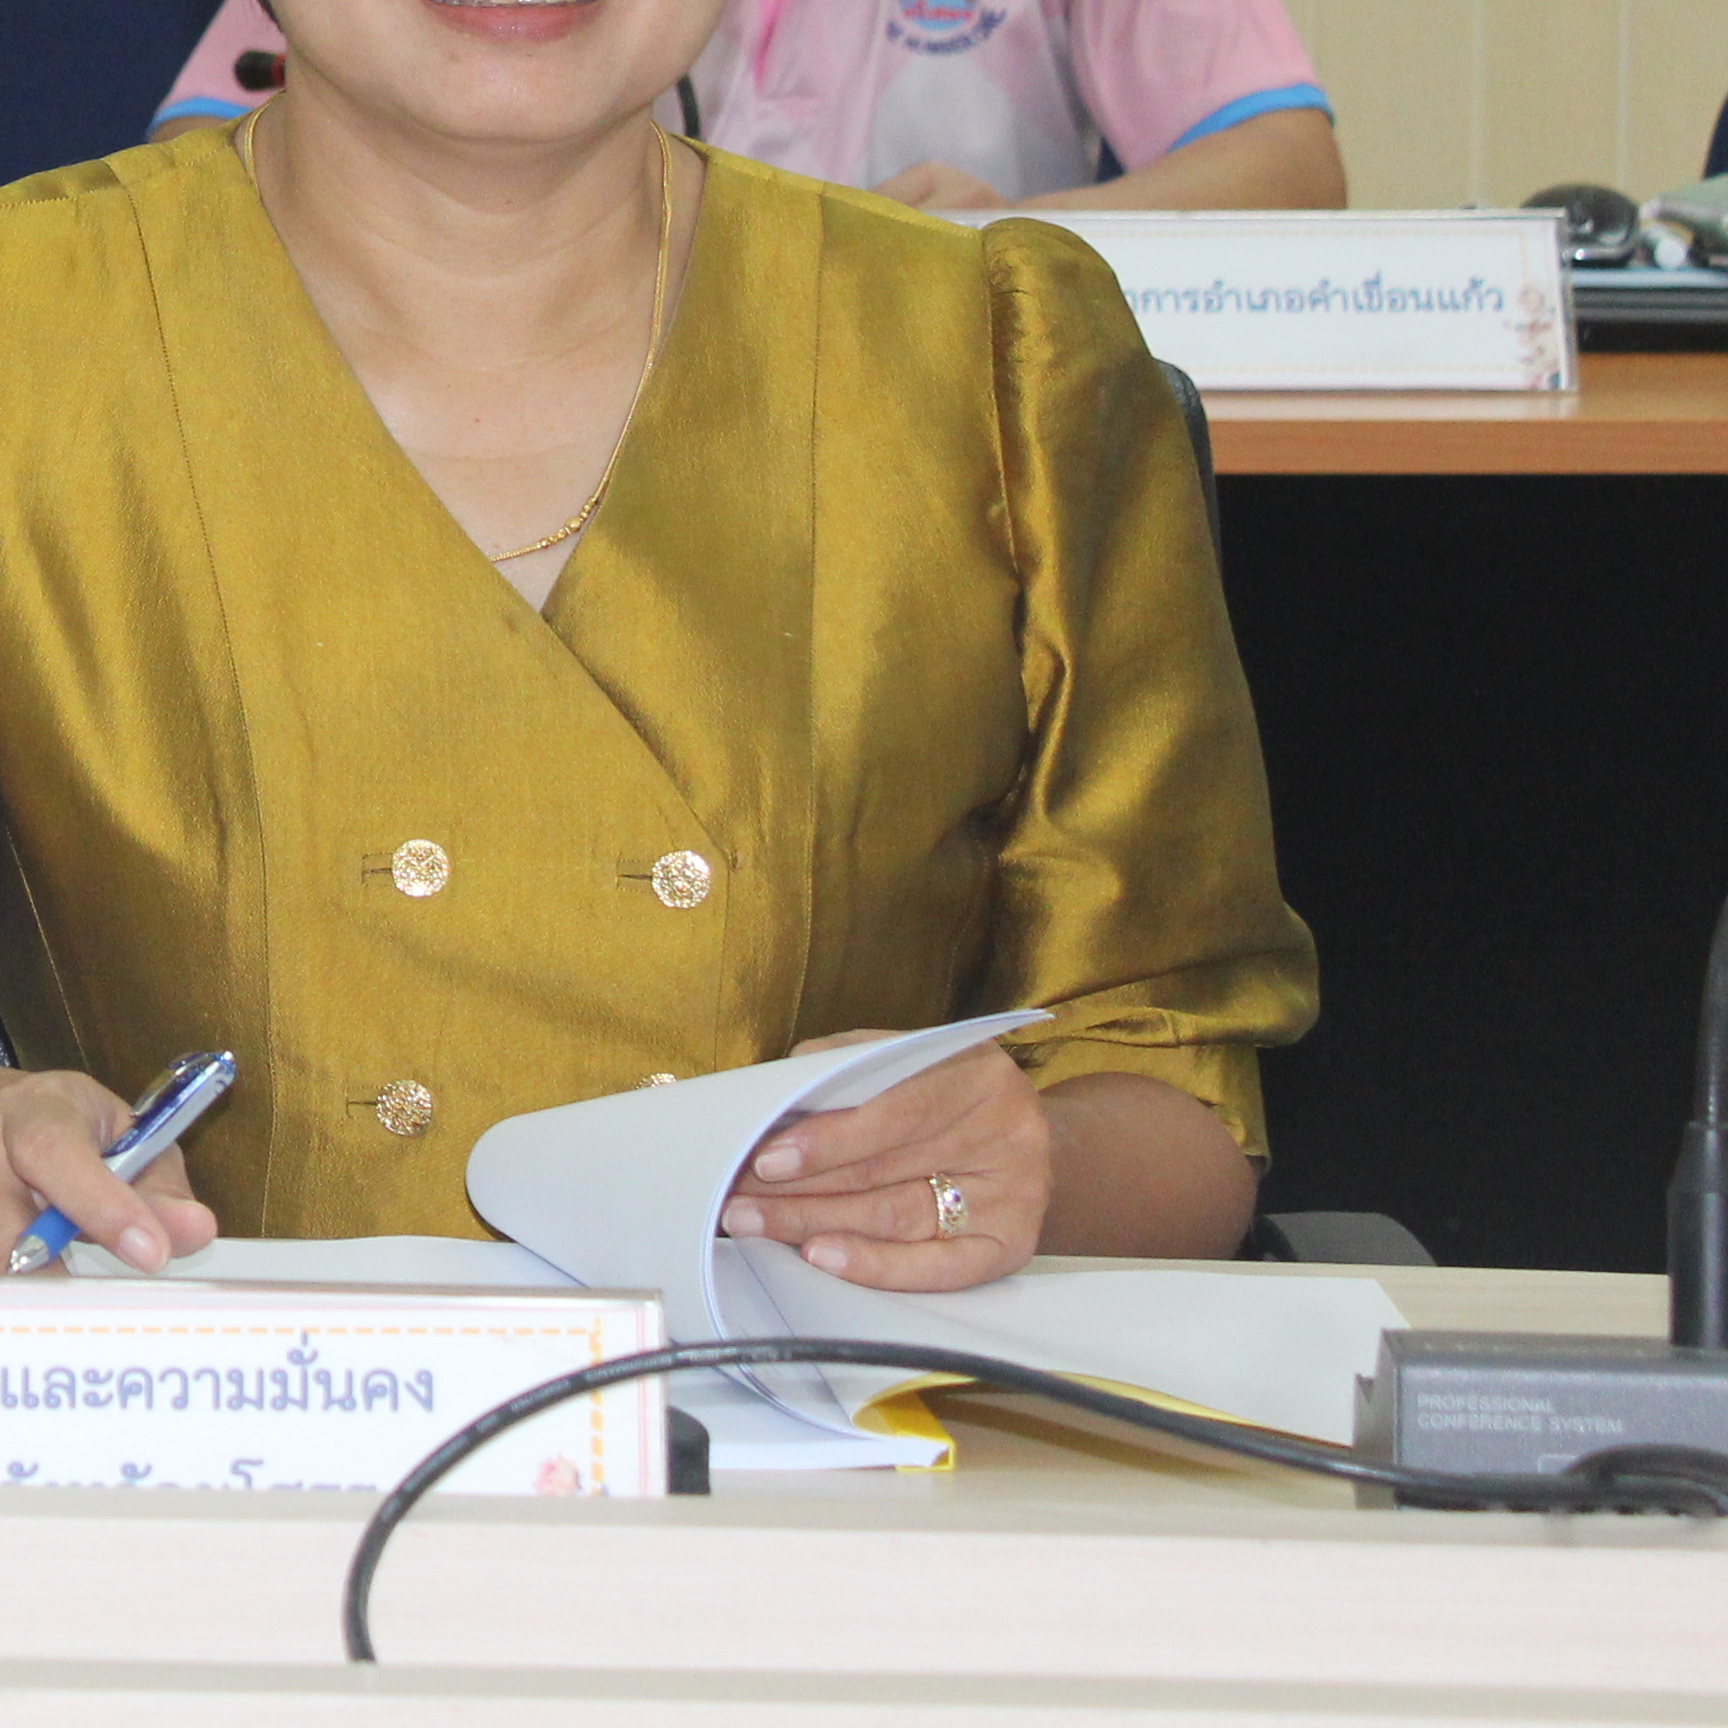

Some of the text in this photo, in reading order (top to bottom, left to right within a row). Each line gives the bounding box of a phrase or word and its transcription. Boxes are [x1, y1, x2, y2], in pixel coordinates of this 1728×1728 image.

[1417, 1392, 1555, 1414] PROFESSIONAL
[1417, 1412, 1626, 1436] CONFERENCE SYSTEM
